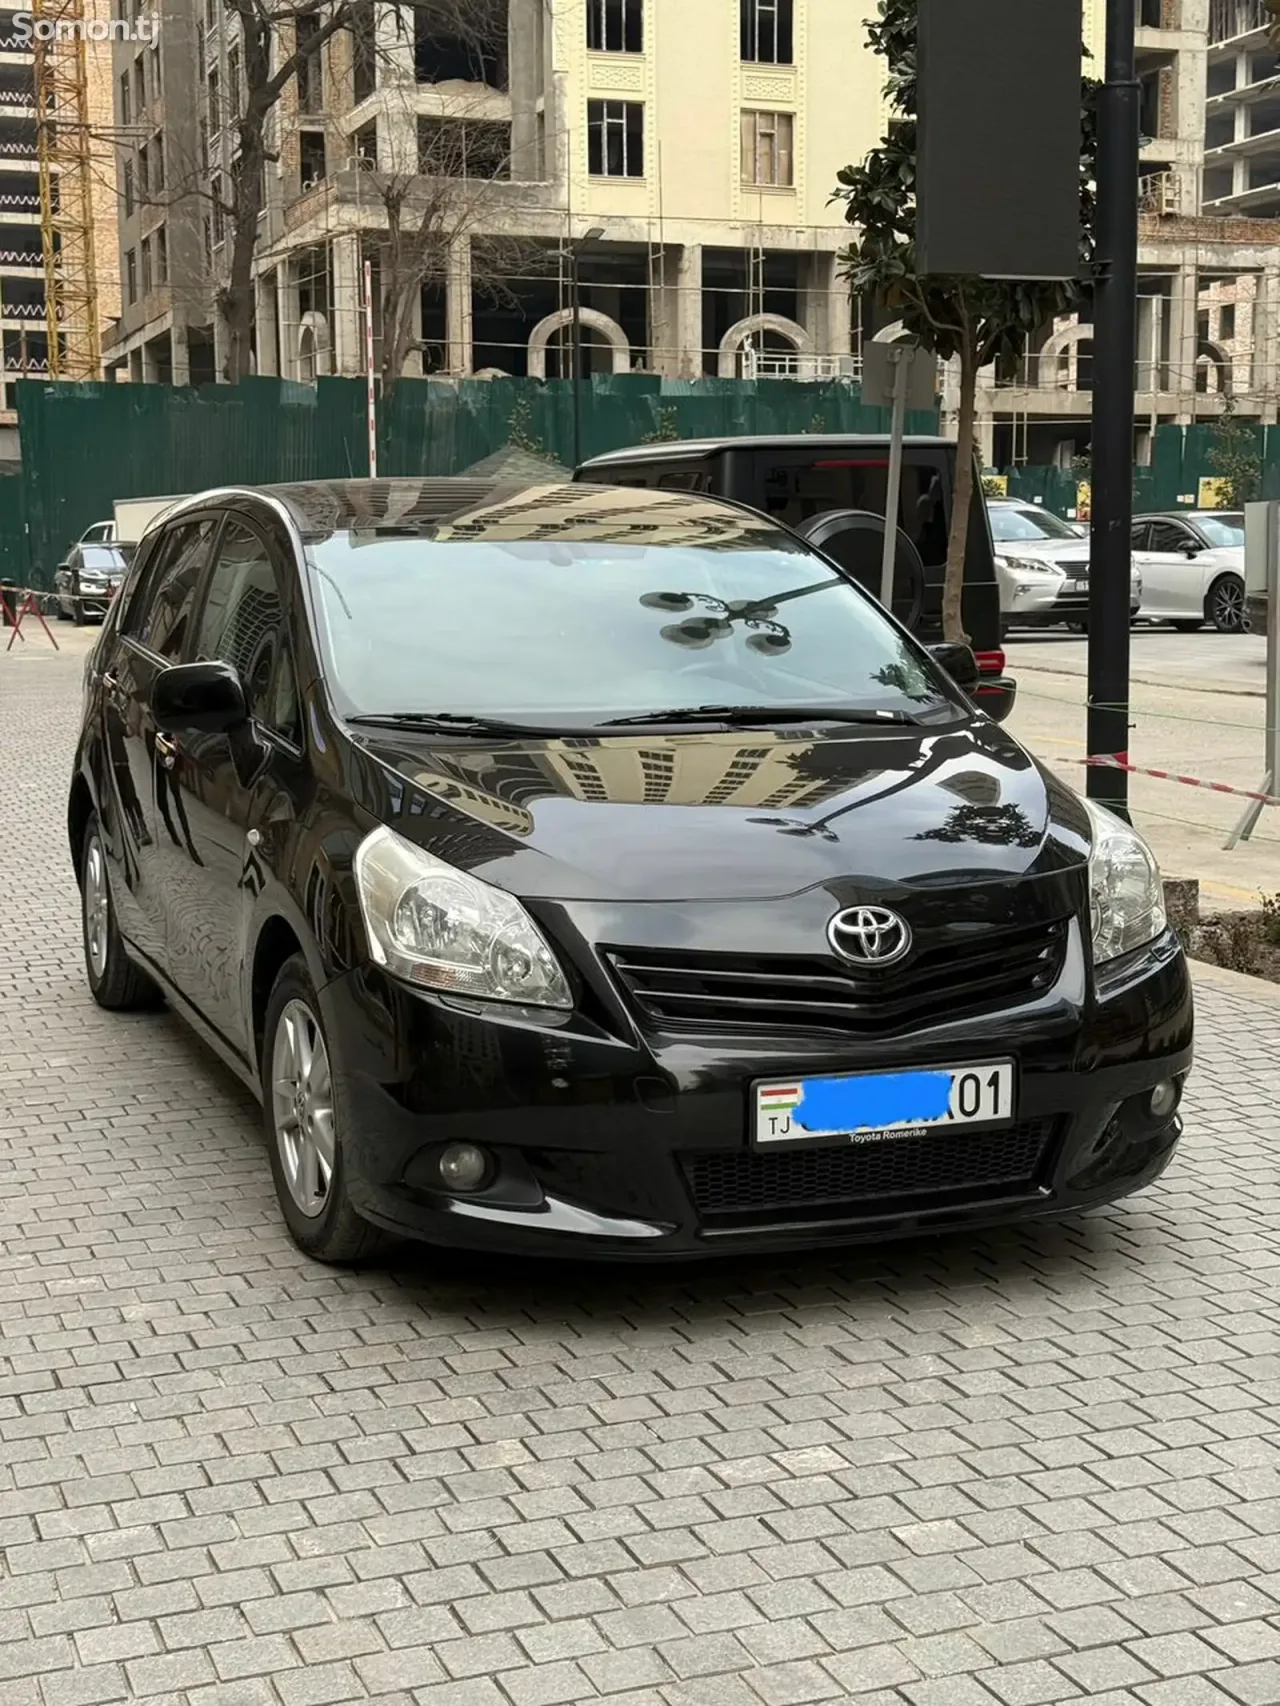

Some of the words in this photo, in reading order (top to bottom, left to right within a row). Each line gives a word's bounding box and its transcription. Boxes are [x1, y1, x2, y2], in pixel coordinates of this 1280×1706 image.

[768, 1116, 790, 1135] TJ
[849, 1133, 882, 1144] Toyota
[882, 1128, 928, 1140] Romerike
